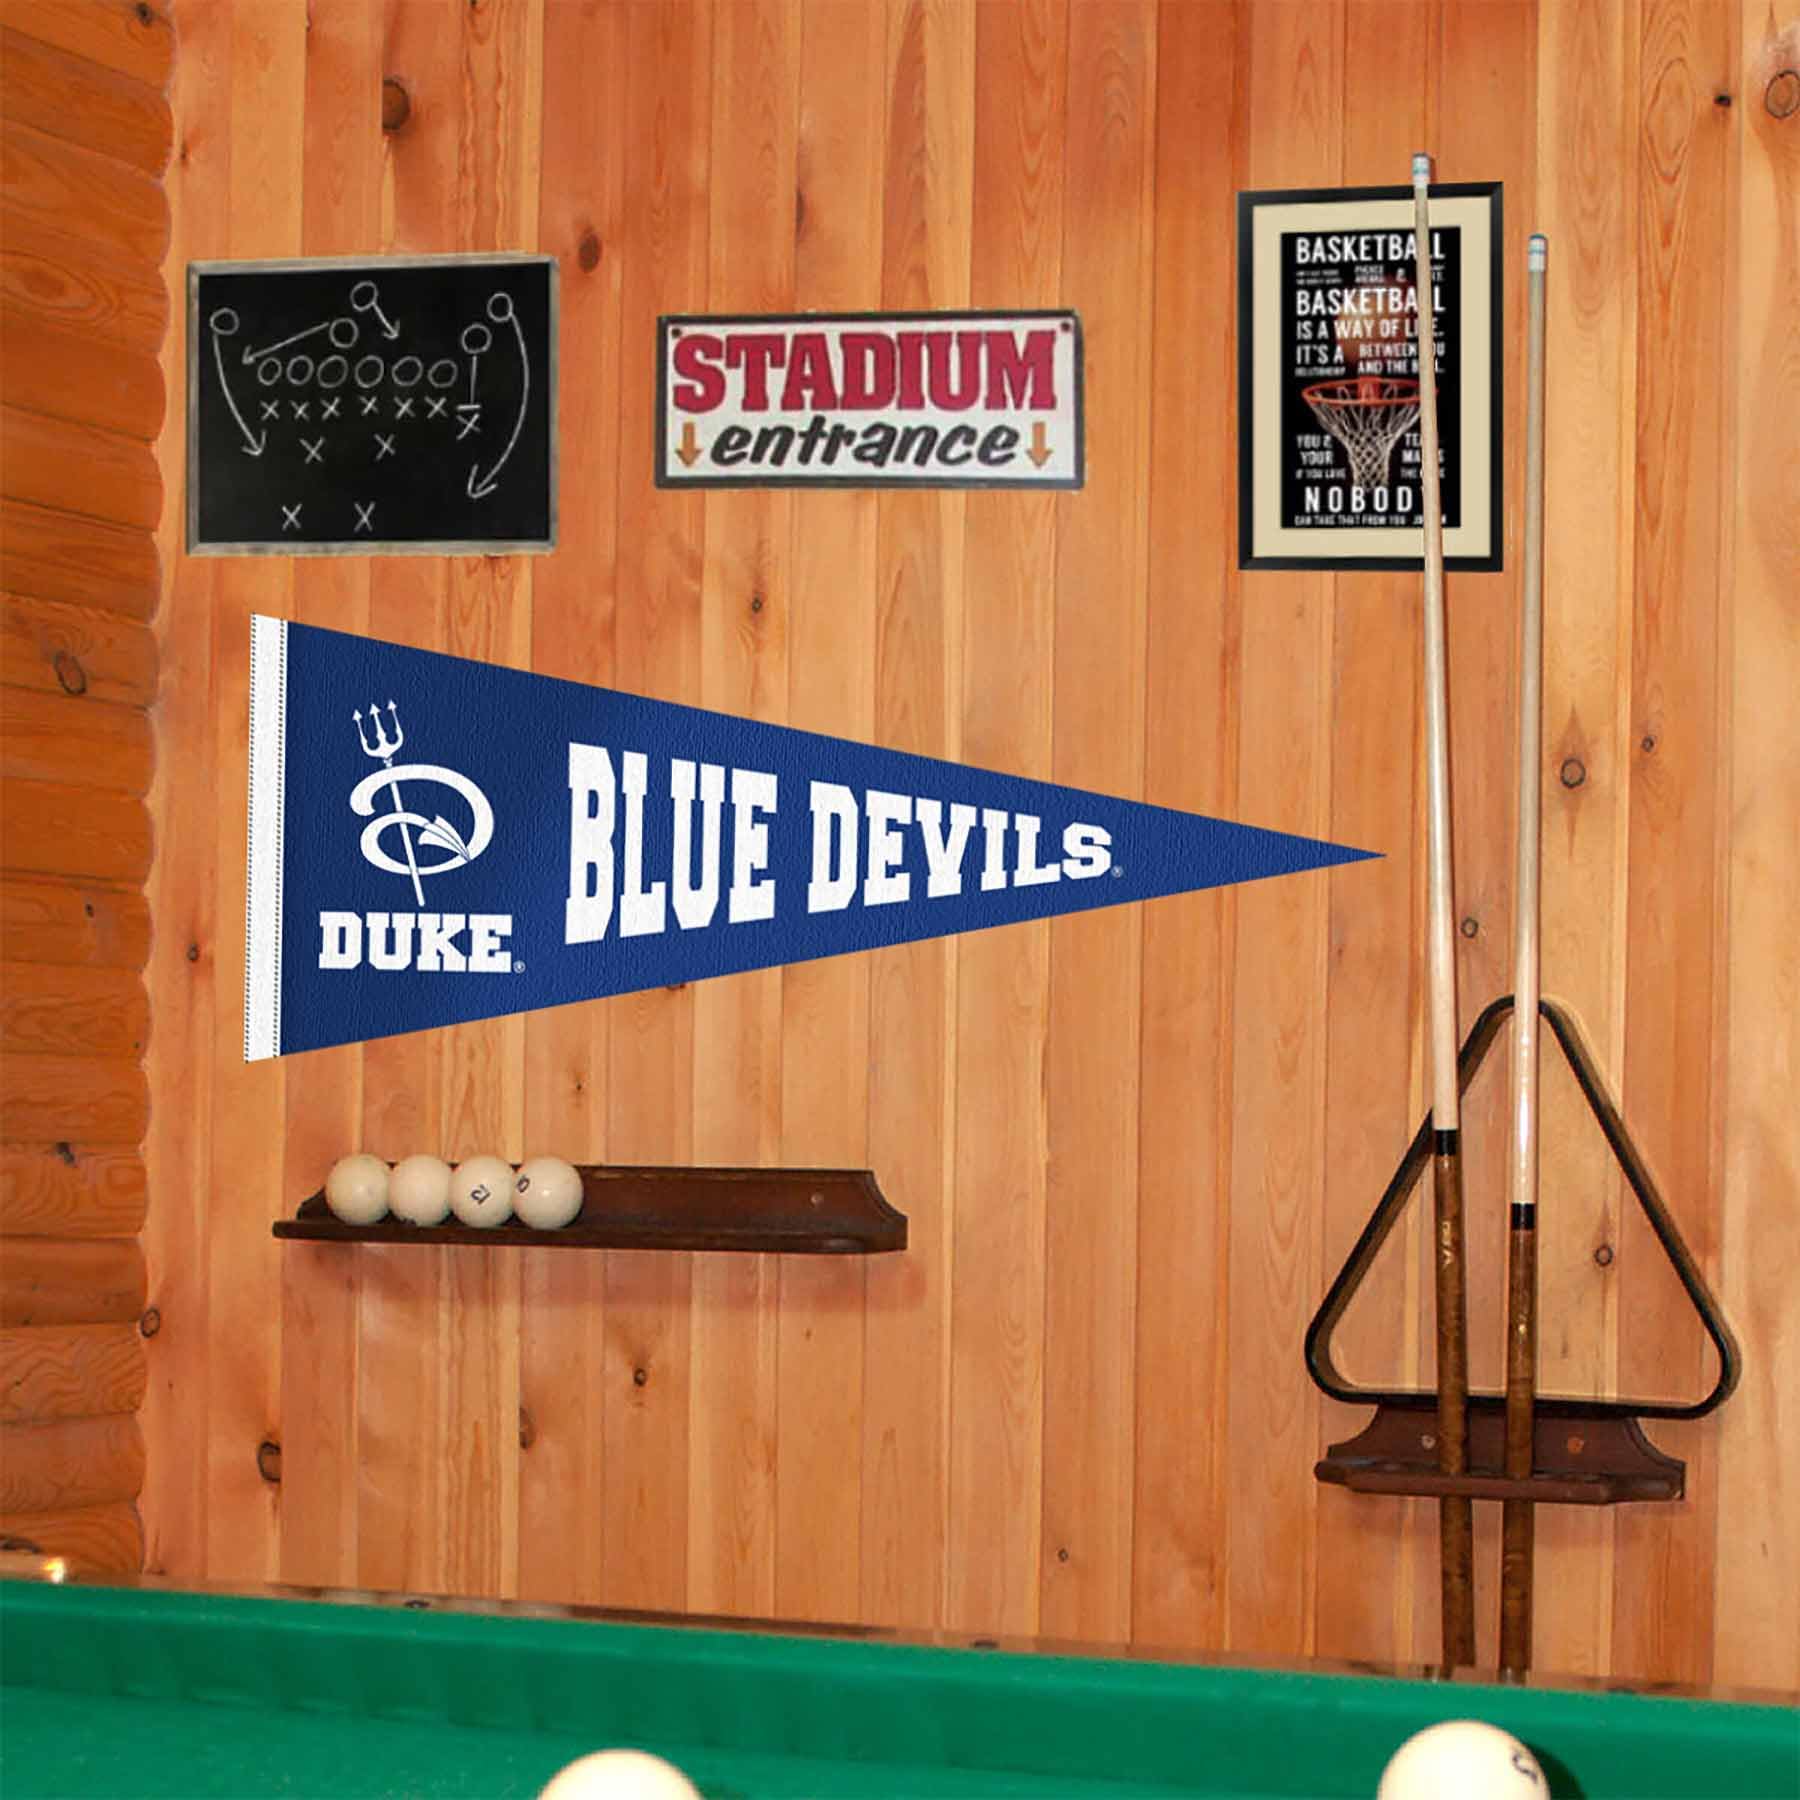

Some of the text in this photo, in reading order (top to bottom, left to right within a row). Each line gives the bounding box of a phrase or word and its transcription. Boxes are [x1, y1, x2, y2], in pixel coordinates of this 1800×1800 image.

[1296, 232, 1446, 265] BASKETBAL
[1296, 286, 1446, 317] BASKETBAL
[1296, 316, 1446, 340] IS A WAY OF LIE.
[1296, 344, 1345, 365] IT'S A
[1357, 359, 1383, 375] AND
[673, 330, 1057, 413] STADIUM
[711, 415, 1020, 467] entrance
[1305, 485, 1425, 513] NOBOD
[565, 742, 1113, 945] BLUE DEVILS
[318, 911, 513, 973] DUKE
